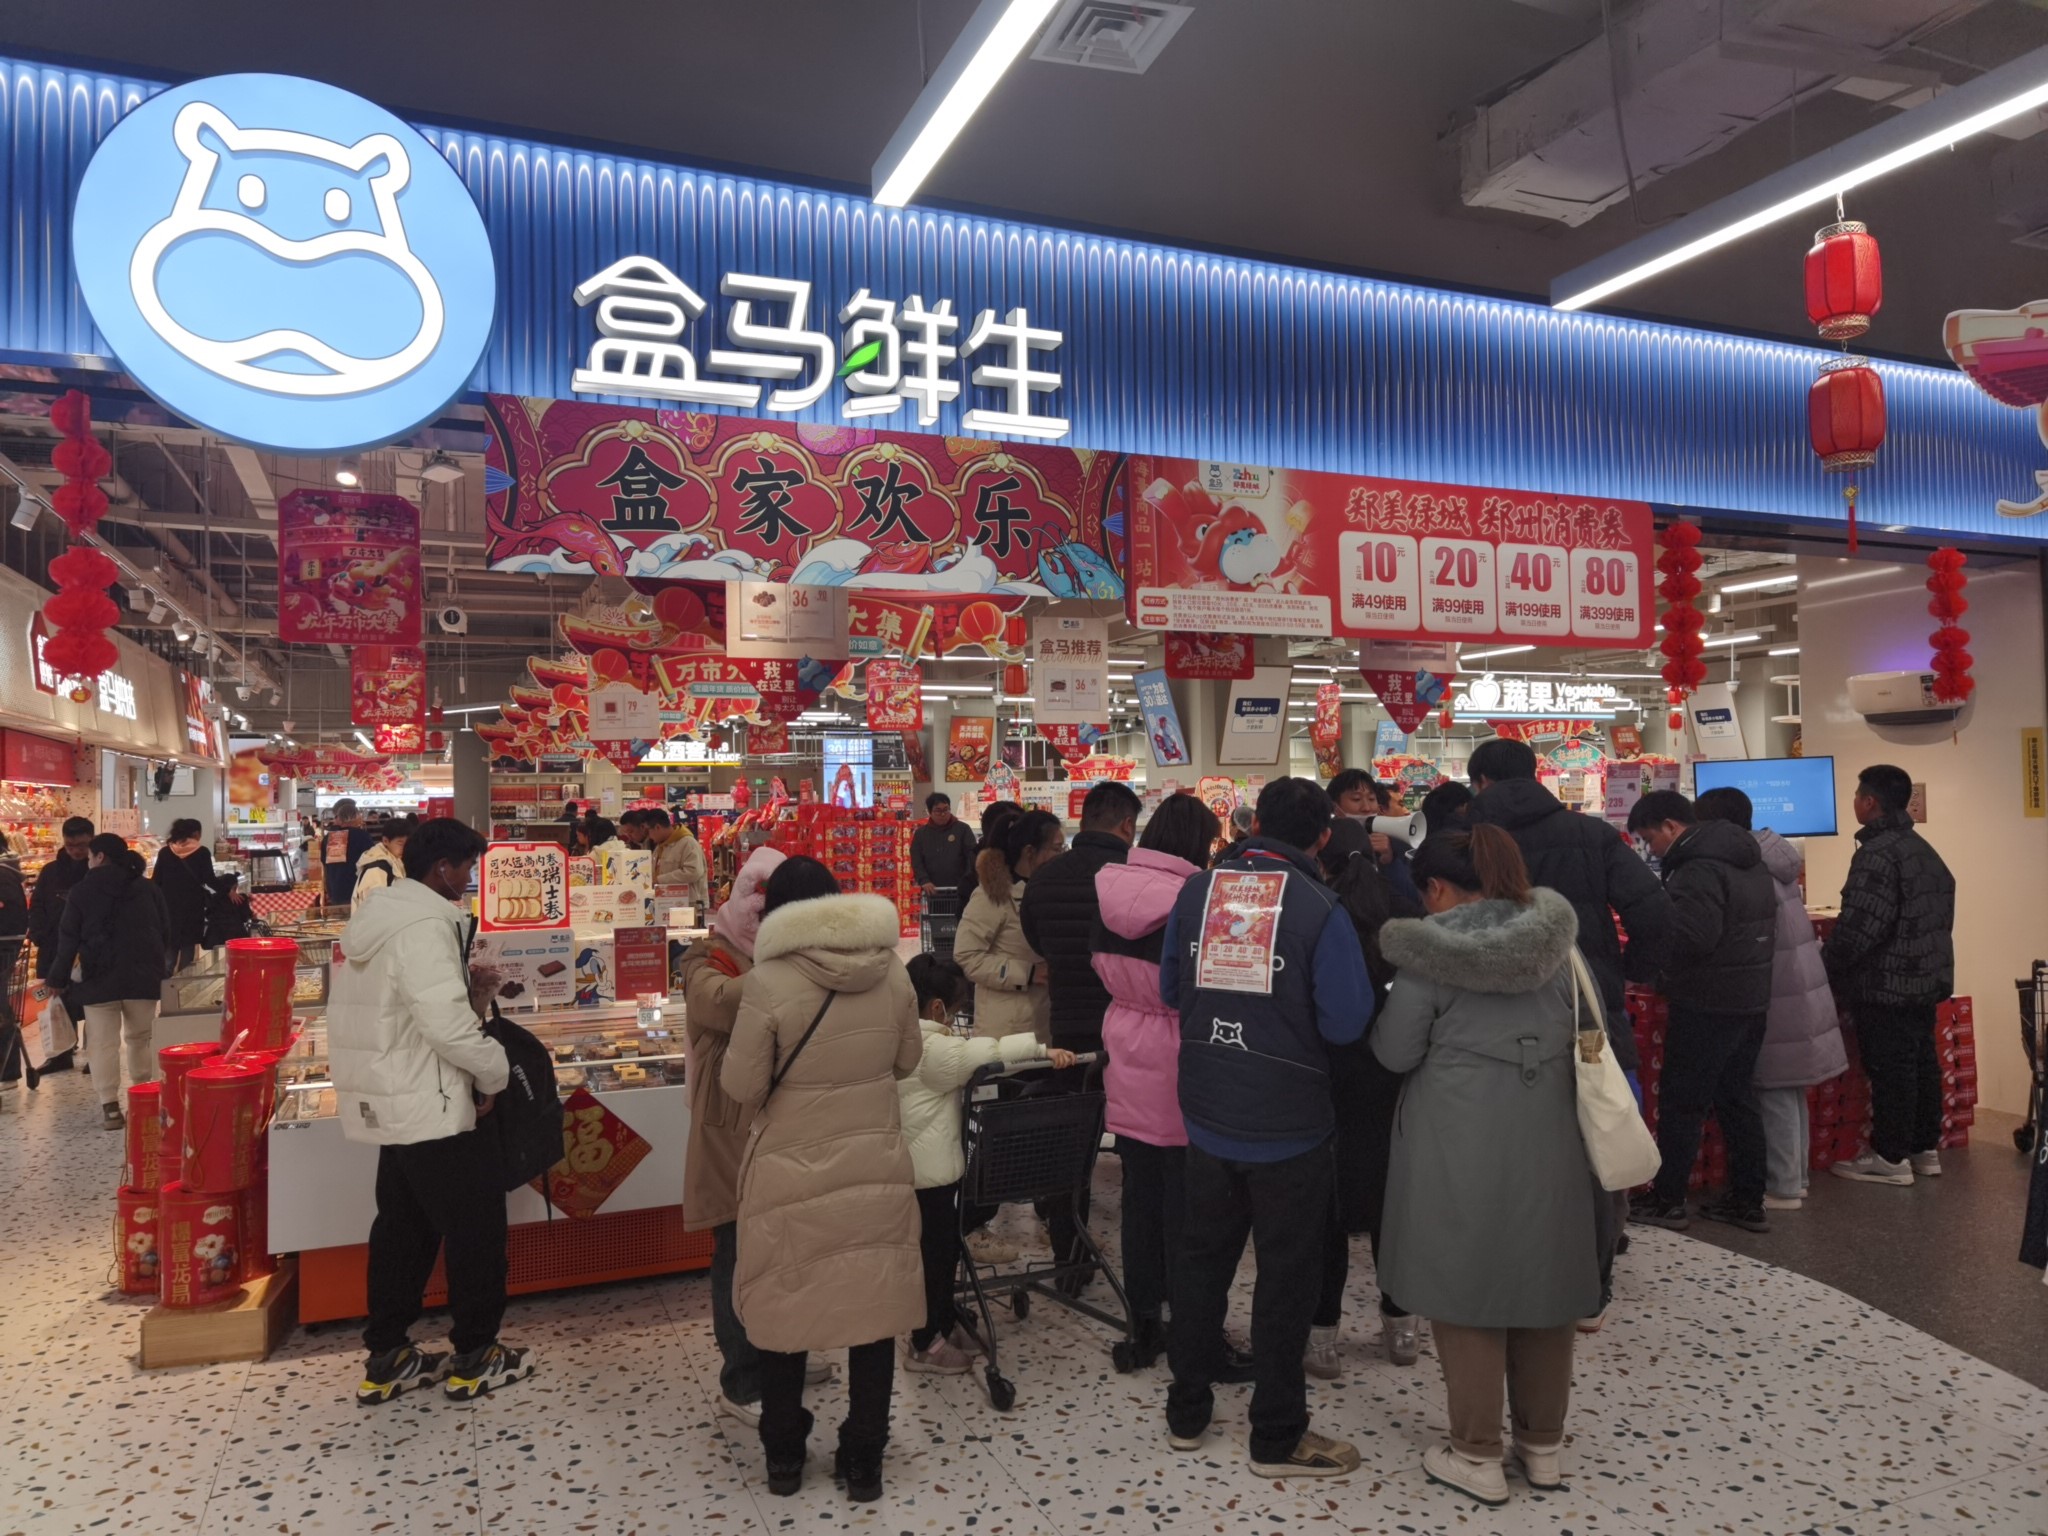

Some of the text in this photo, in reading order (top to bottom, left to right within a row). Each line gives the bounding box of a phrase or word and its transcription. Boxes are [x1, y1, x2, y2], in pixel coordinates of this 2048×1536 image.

[572, 255, 1070, 438] 盒马鲜生
[597, 445, 1034, 558] 盒家欢乐
[1345, 487, 1632, 549] 郑美绿城 郑州消费券
[793, 590, 808, 608] 36
[1352, 594, 1406, 611] 满49使用
[1432, 598, 1484, 615] 满99使用
[1505, 601, 1561, 619] 满199使用
[1580, 605, 1635, 622] 满399使用
[1039, 638, 1102, 655] 盒马推荐
[756, 679, 796, 693] 在这里
[1075, 679, 1086, 690] 36
[1555, 683, 1616, 698] Vegetable
[1382, 692, 1413, 705] 在这里
[1503, 679, 1554, 713] 蔬果
[628, 701, 638, 711] 79
[1053, 737, 1078, 746] 在这里
[607, 751, 630, 759] 在这里
[1608, 797, 1624, 808] 239
[542, 867, 564, 920] 瑞士卷
